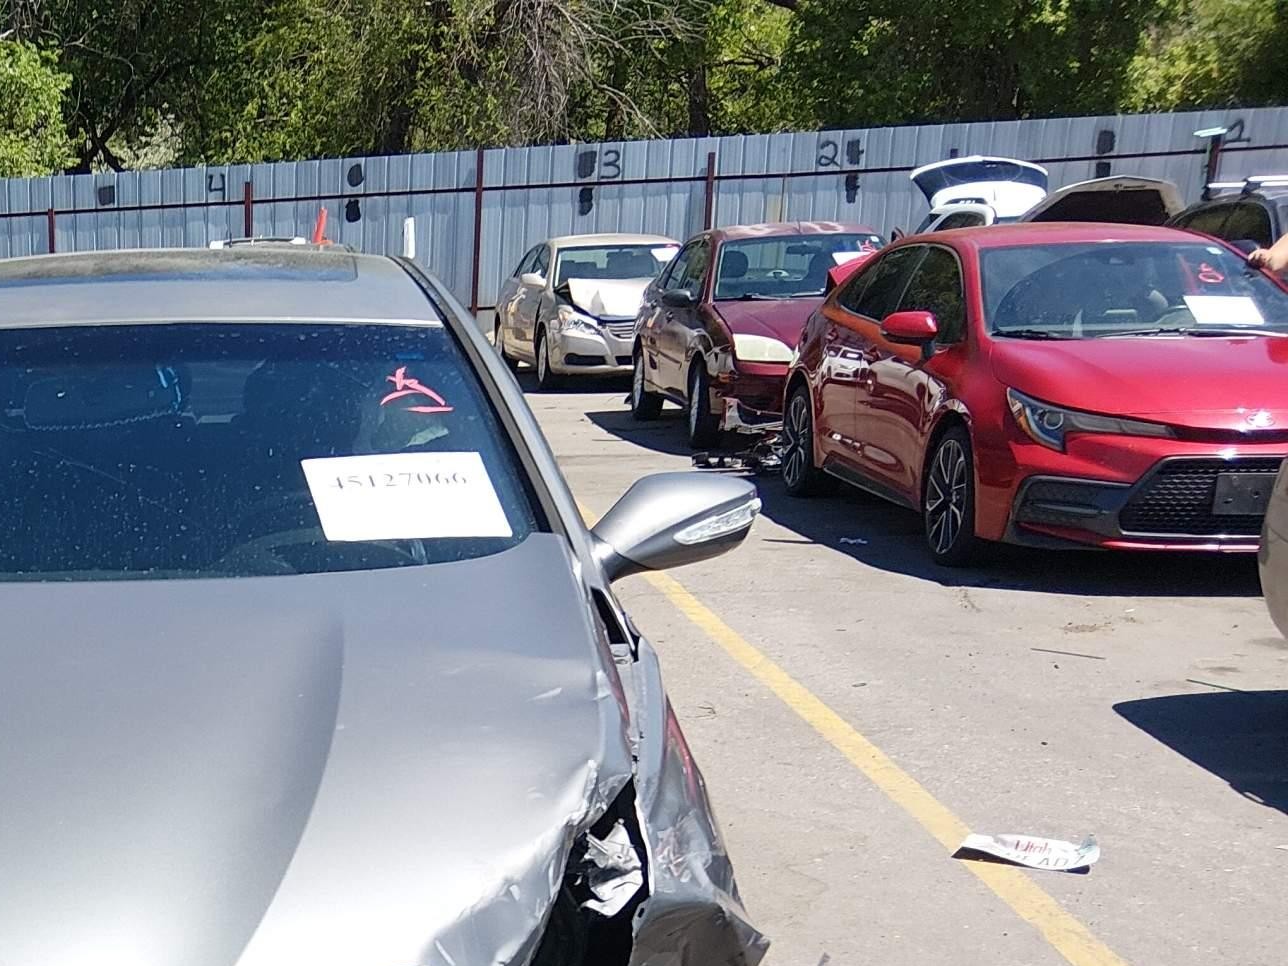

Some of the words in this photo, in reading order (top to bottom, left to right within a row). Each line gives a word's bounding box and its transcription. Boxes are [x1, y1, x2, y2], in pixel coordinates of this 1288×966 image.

[599, 149, 621, 179] 3
[817, 140, 840, 167] 2
[207, 173, 226, 201] 4
